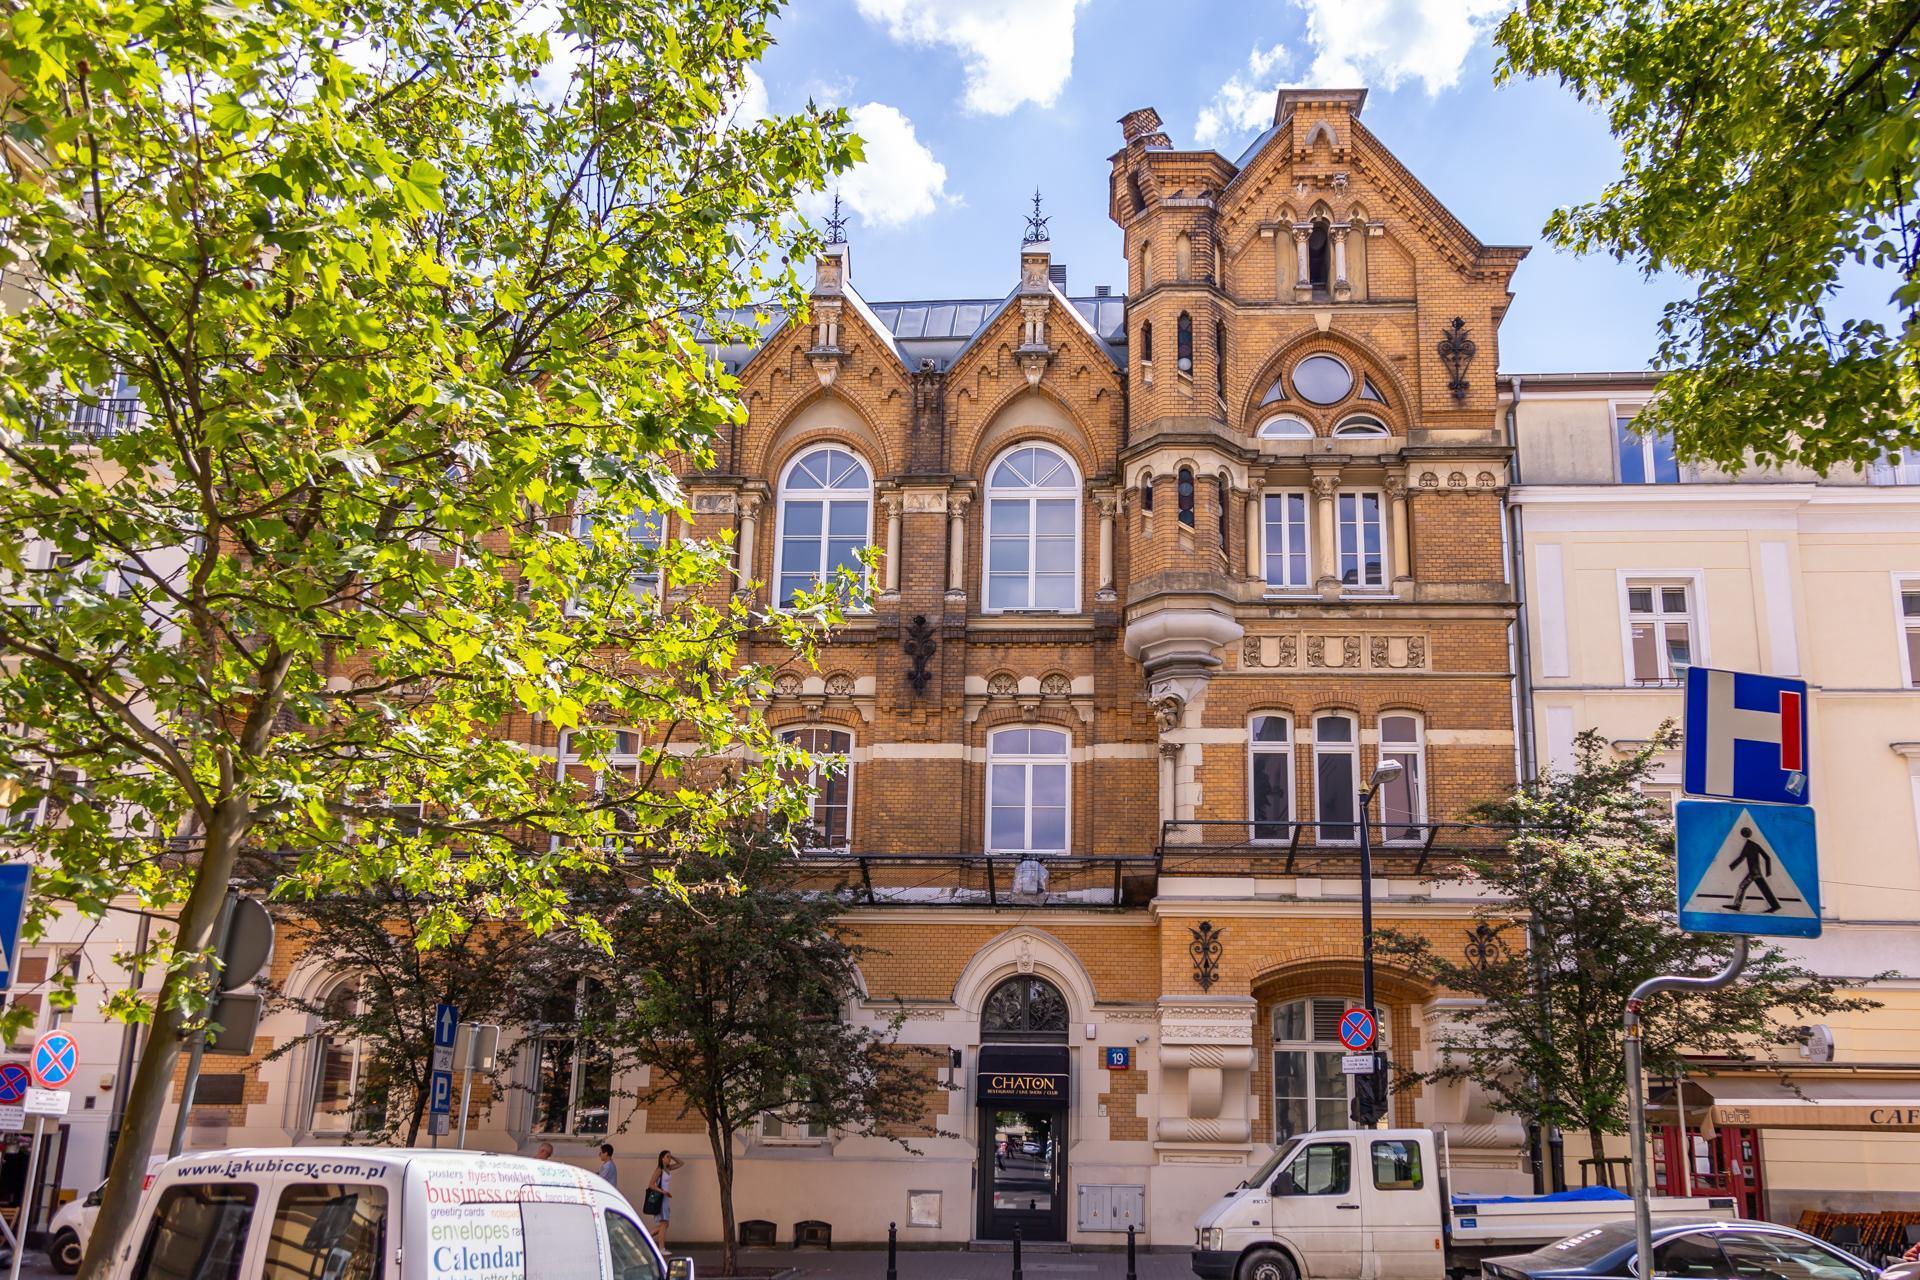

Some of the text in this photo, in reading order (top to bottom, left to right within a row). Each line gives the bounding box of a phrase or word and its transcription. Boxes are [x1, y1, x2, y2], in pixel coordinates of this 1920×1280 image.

[1112, 1053, 1124, 1064] 19
[435, 1077, 448, 1108] P
[992, 1076, 1055, 1089] CHATON
[177, 1160, 387, 1180] www.jakubiccy.com.pl
[467, 1168, 497, 1185] flyers
[424, 1180, 543, 1203] business cards
[464, 1207, 485, 1216] cards
[431, 1220, 510, 1244] envelopes
[433, 1245, 524, 1273] Calendar
